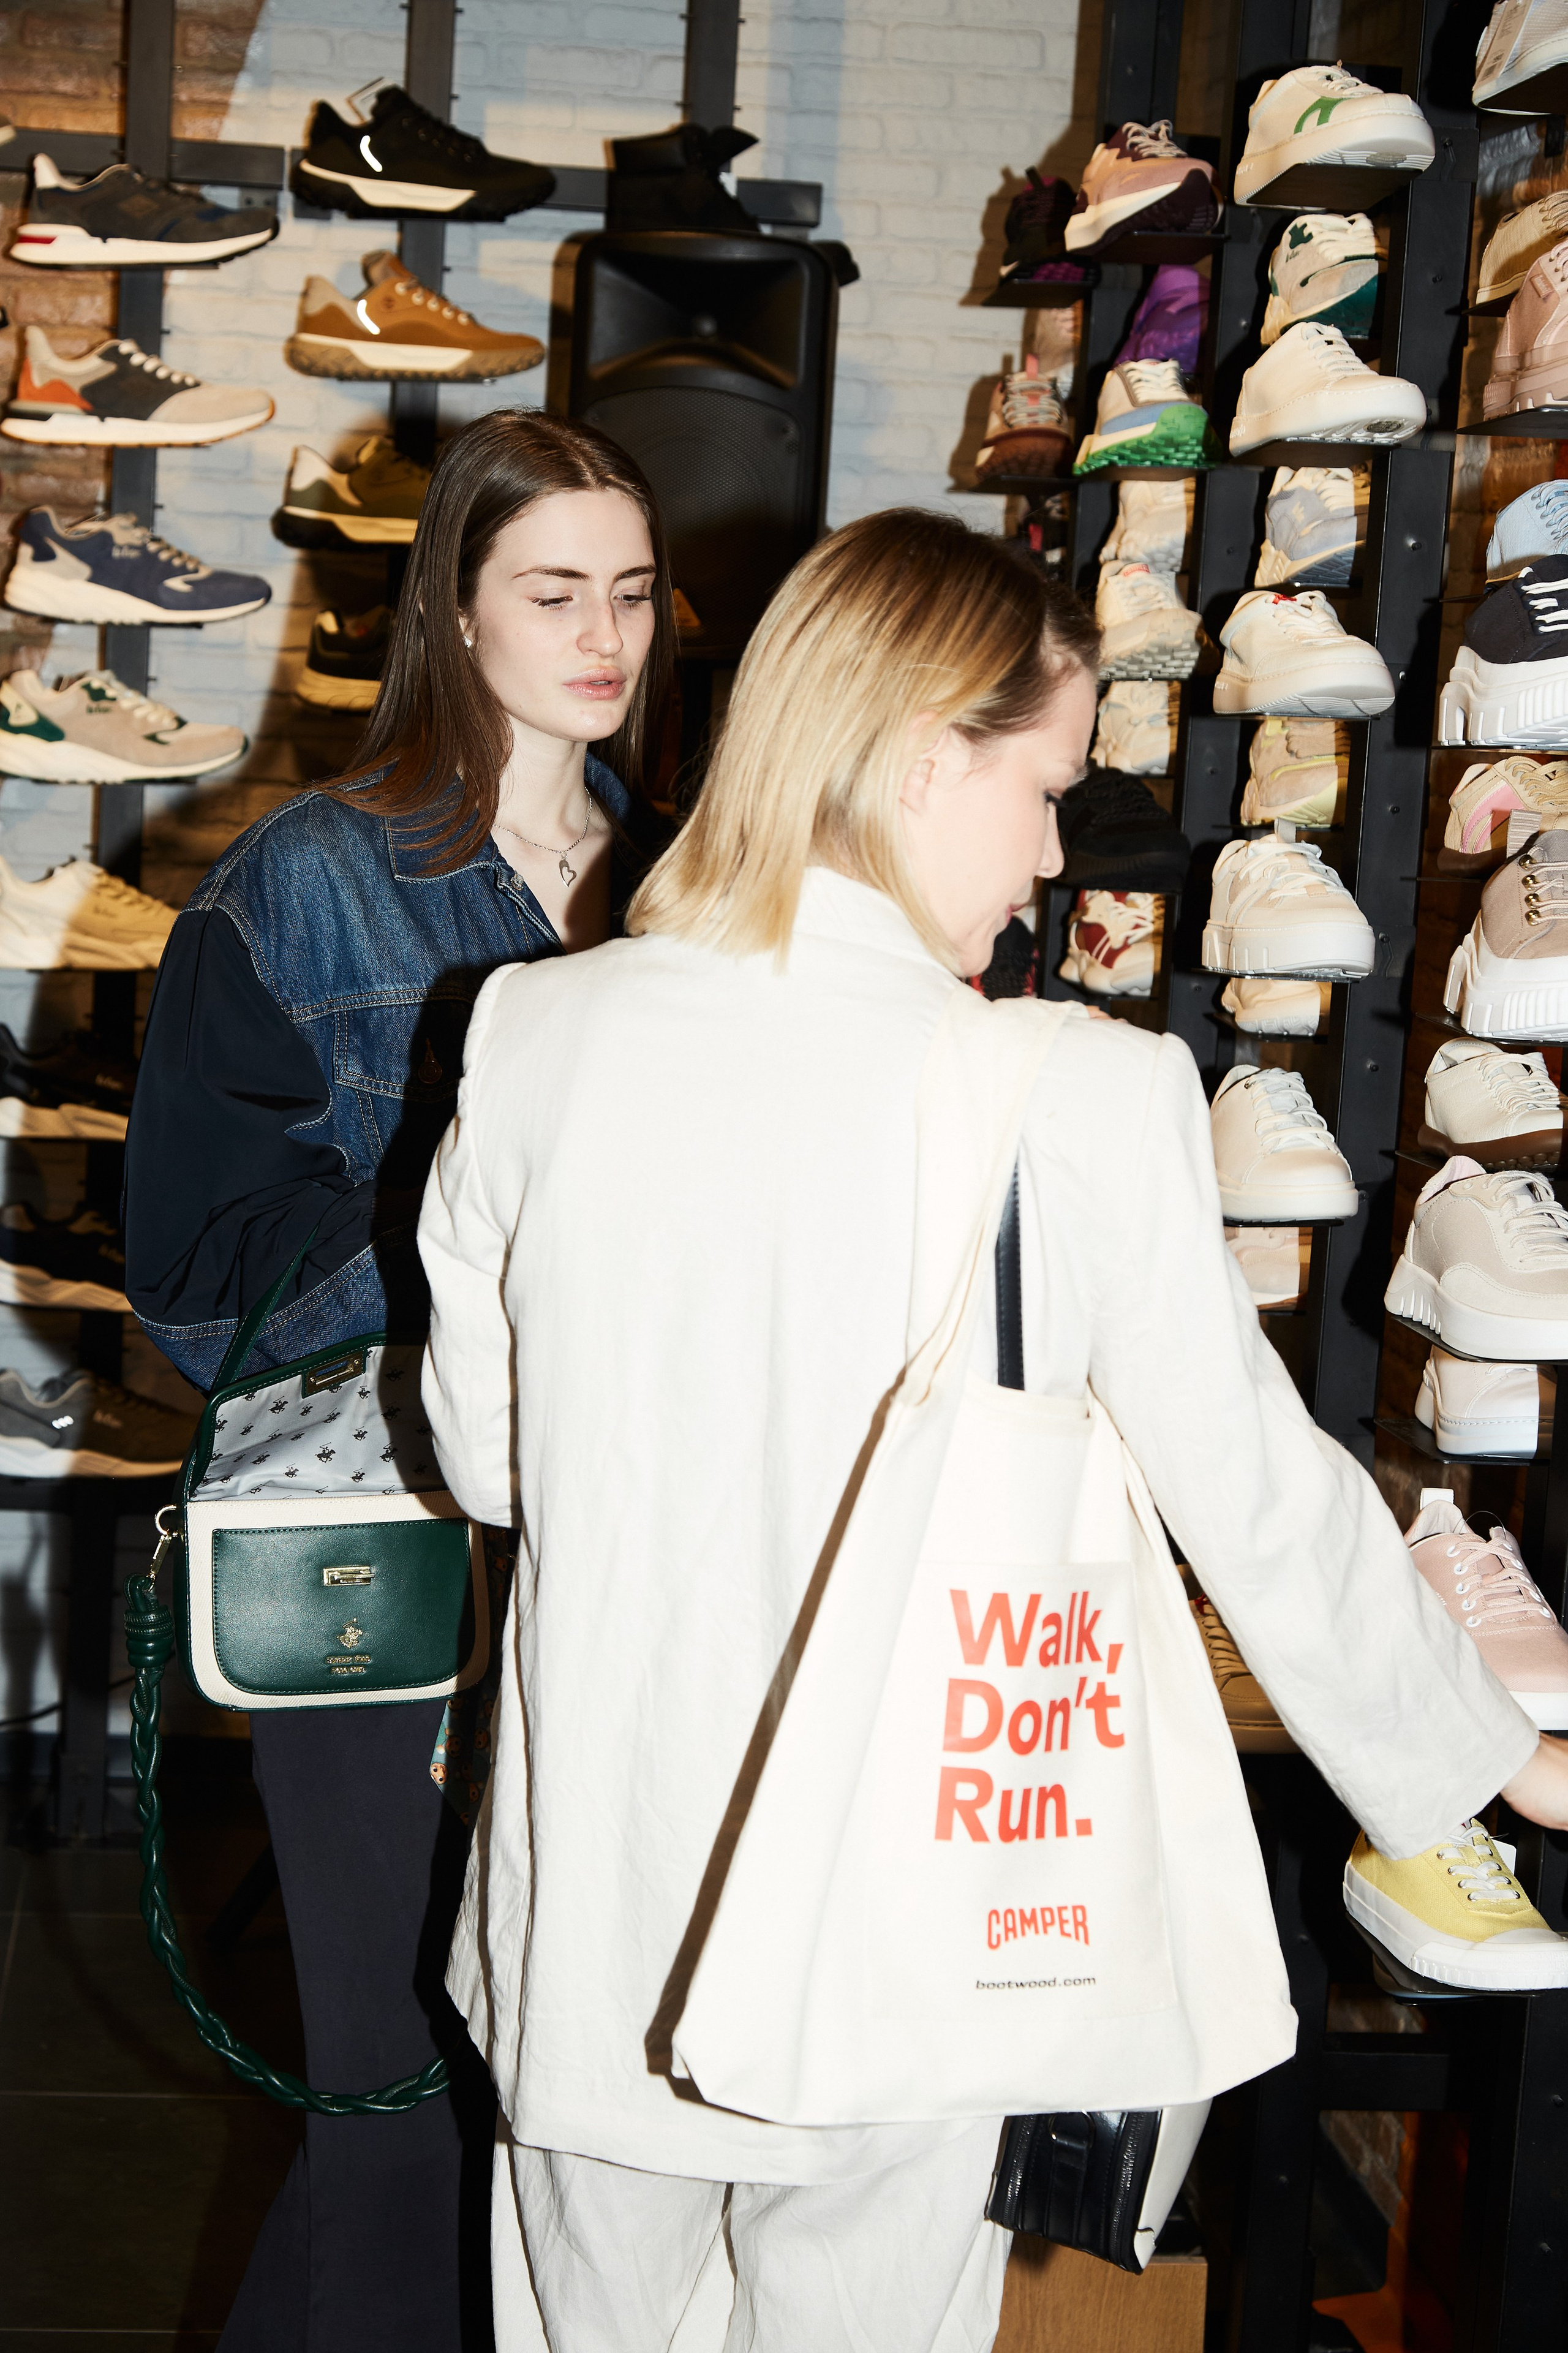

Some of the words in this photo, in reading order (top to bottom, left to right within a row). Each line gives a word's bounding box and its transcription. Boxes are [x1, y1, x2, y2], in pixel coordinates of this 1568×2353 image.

[949, 1588, 1124, 1674] Walk,
[943, 1676, 1125, 1756] Don't
[935, 1766, 1093, 1844] Run.
[987, 1905, 1090, 1951] CAMPER
[976, 1977, 1096, 1990] bootwood.com
